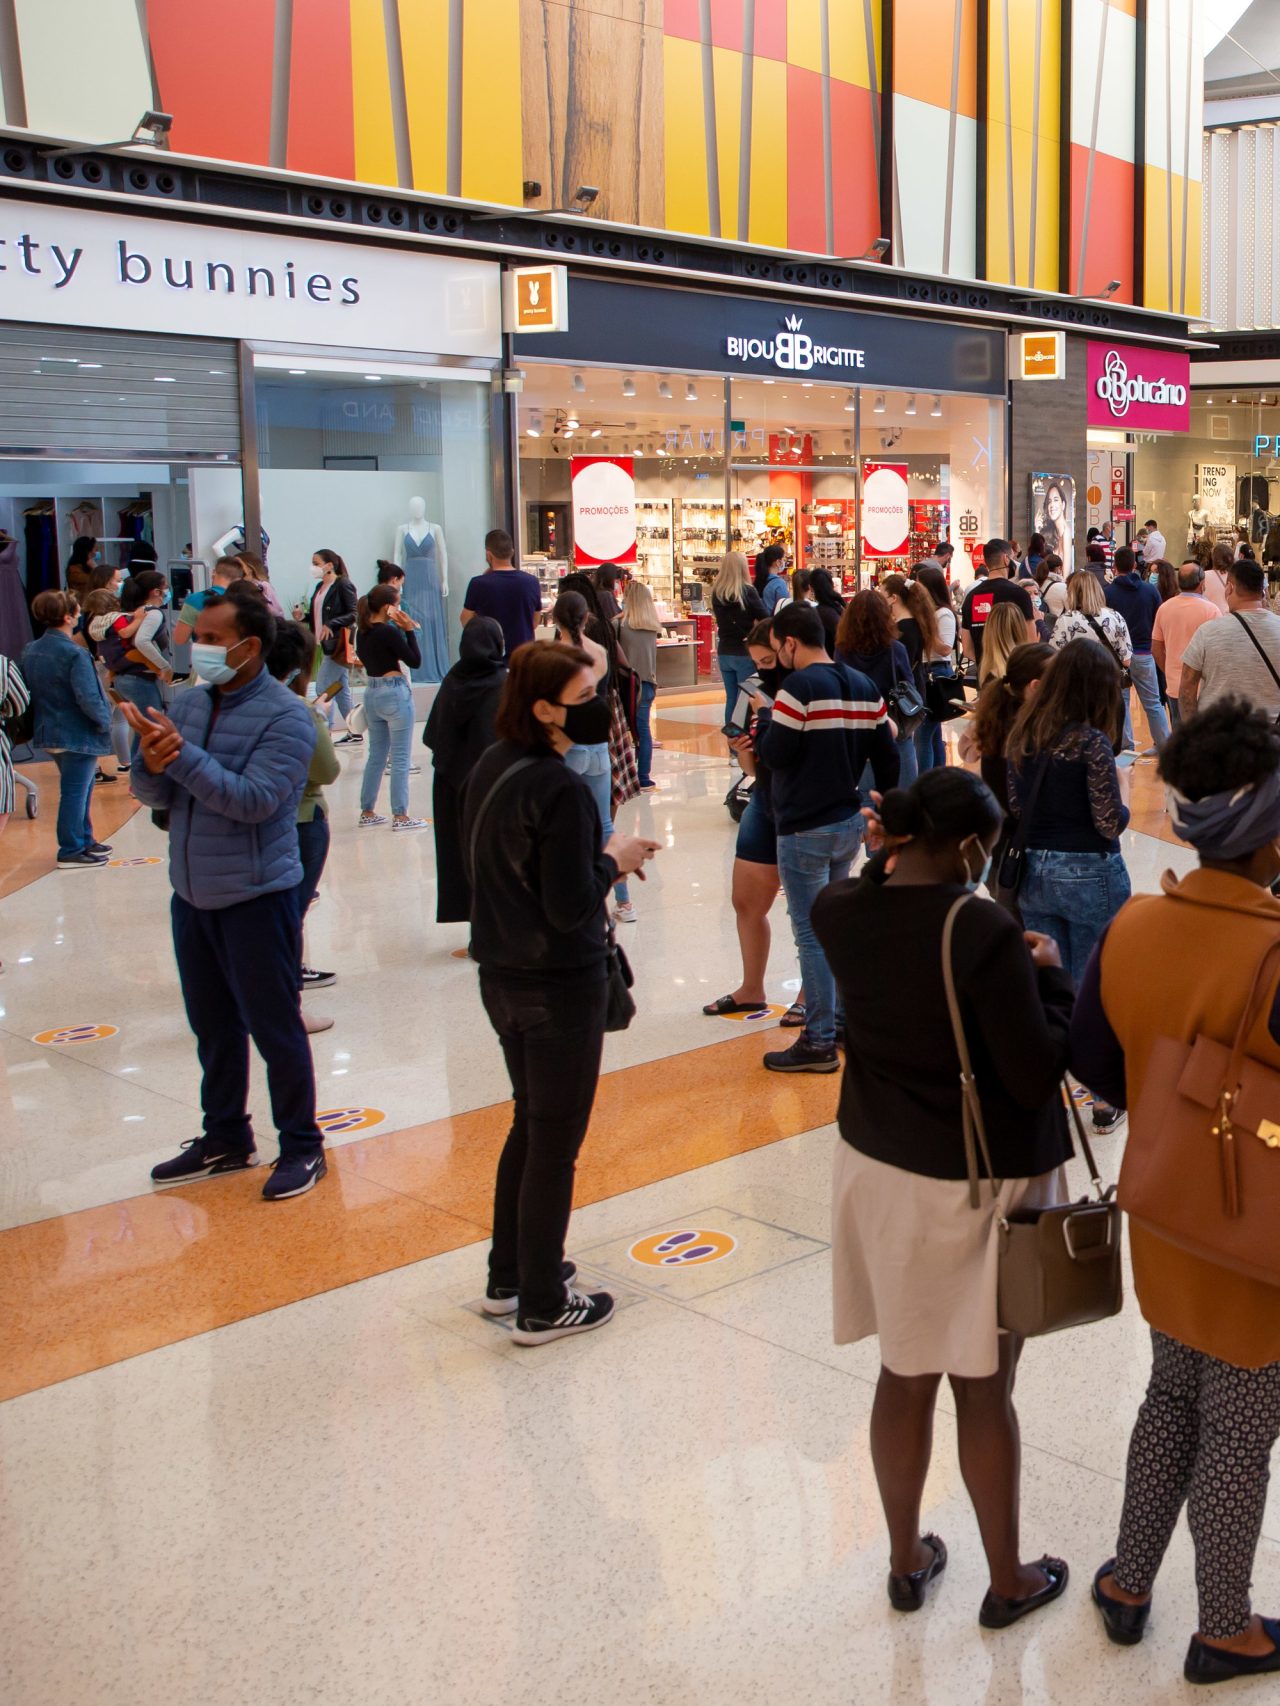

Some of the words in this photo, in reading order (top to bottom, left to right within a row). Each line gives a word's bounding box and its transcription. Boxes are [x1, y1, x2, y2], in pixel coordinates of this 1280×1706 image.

[0, 234, 84, 288] ty
[118, 239, 361, 305] bunnies
[727, 336, 775, 361] BIJOU
[1202, 466, 1227, 477] TREND
[1202, 477, 1218, 487] ING
[1202, 487, 1222, 498] NOW
[579, 505, 629, 516] PROMOÇÕES
